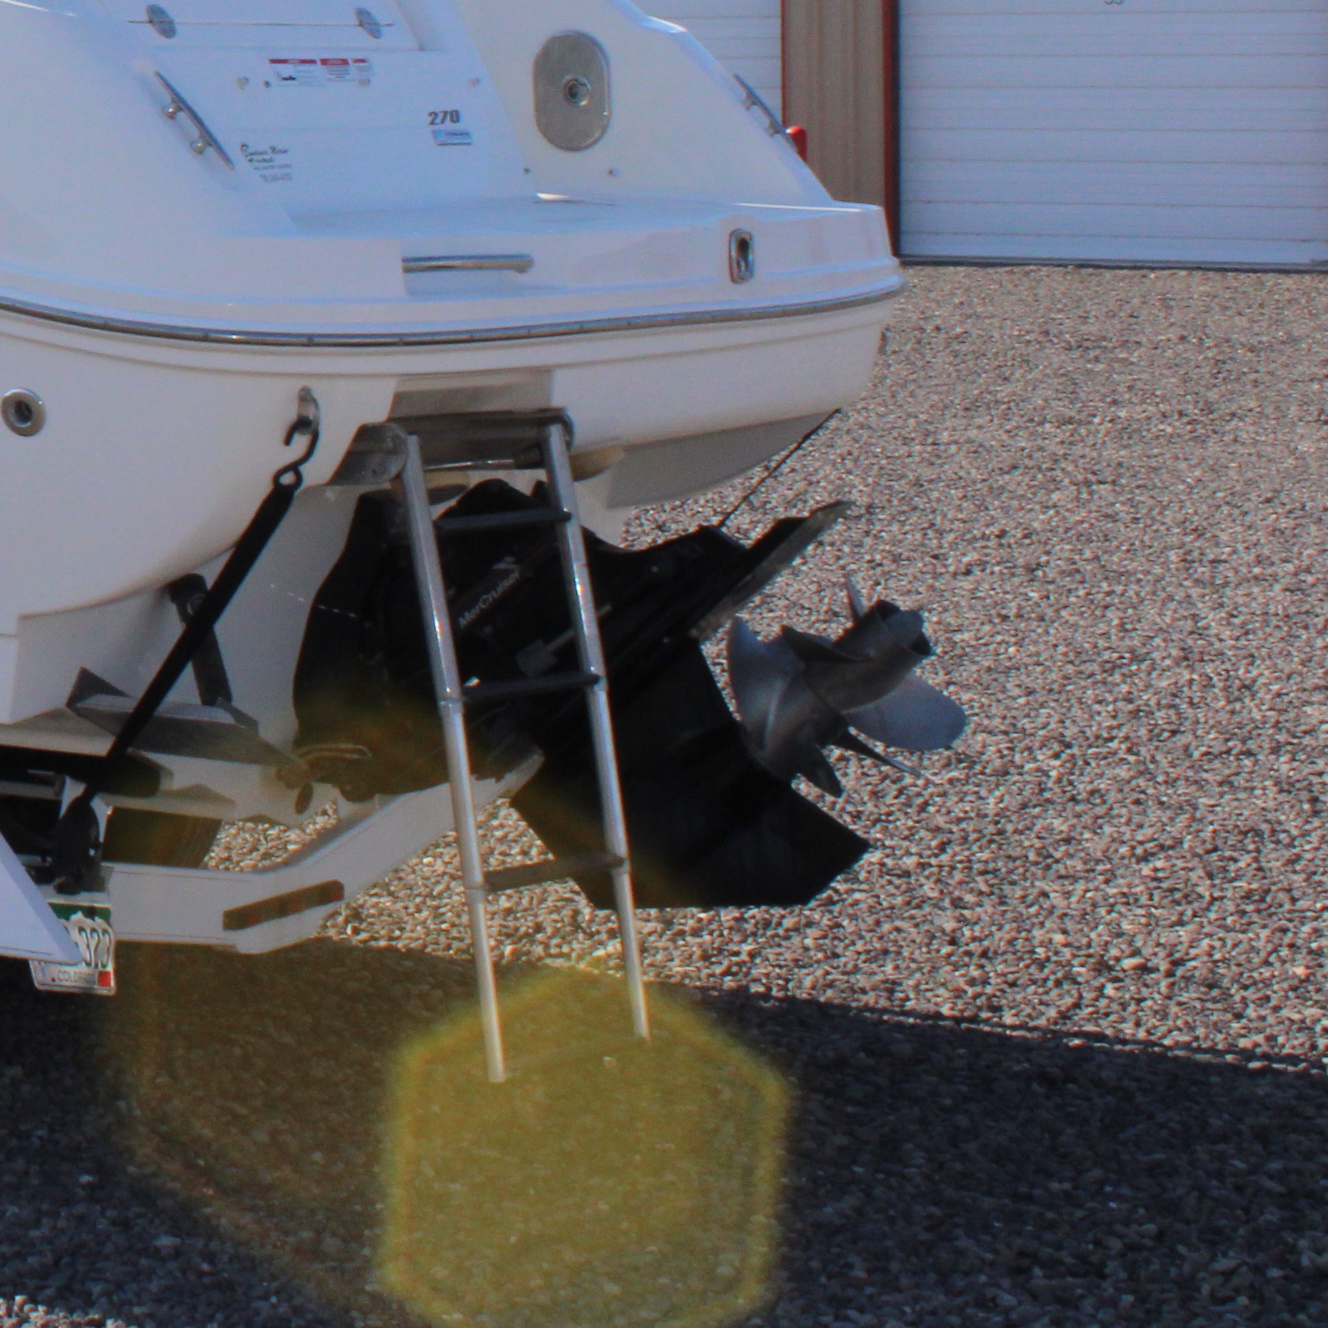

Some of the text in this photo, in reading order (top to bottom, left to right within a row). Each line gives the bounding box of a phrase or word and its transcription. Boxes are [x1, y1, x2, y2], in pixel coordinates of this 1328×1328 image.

[427, 110, 460, 125] 270
[457, 569, 521, 629] MerCruiser
[66, 925, 112, 969] 323
